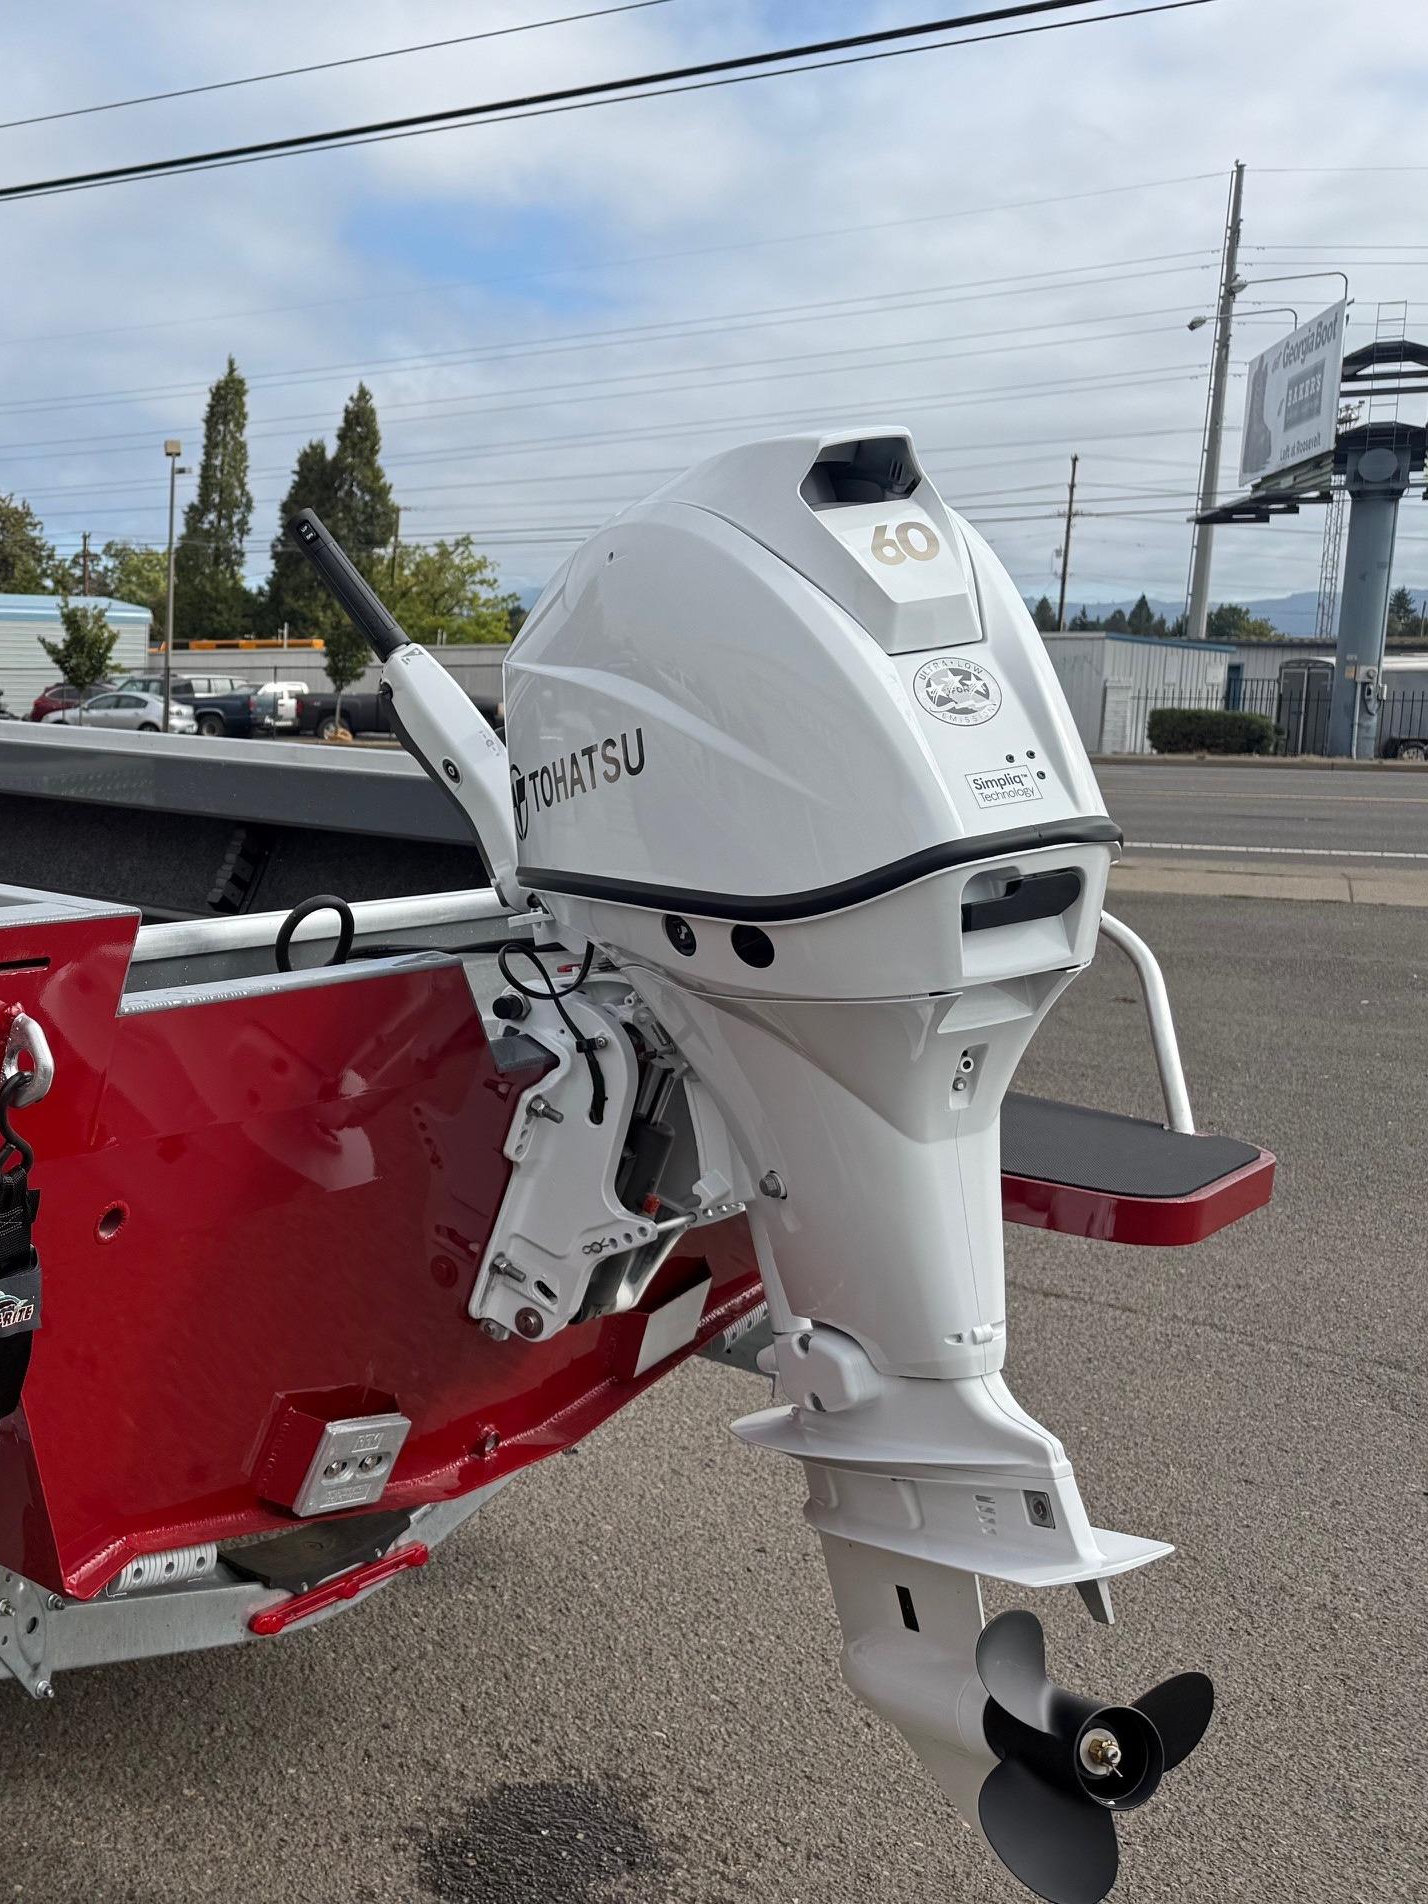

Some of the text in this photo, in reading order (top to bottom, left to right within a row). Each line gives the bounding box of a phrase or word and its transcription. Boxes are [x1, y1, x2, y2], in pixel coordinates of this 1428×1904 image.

[1283, 327, 1314, 368] Georgia
[1315, 312, 1338, 351] Boot
[870, 521, 940, 566] 60
[528, 727, 645, 812] TOHATSU
[979, 786, 1035, 803] Technology
